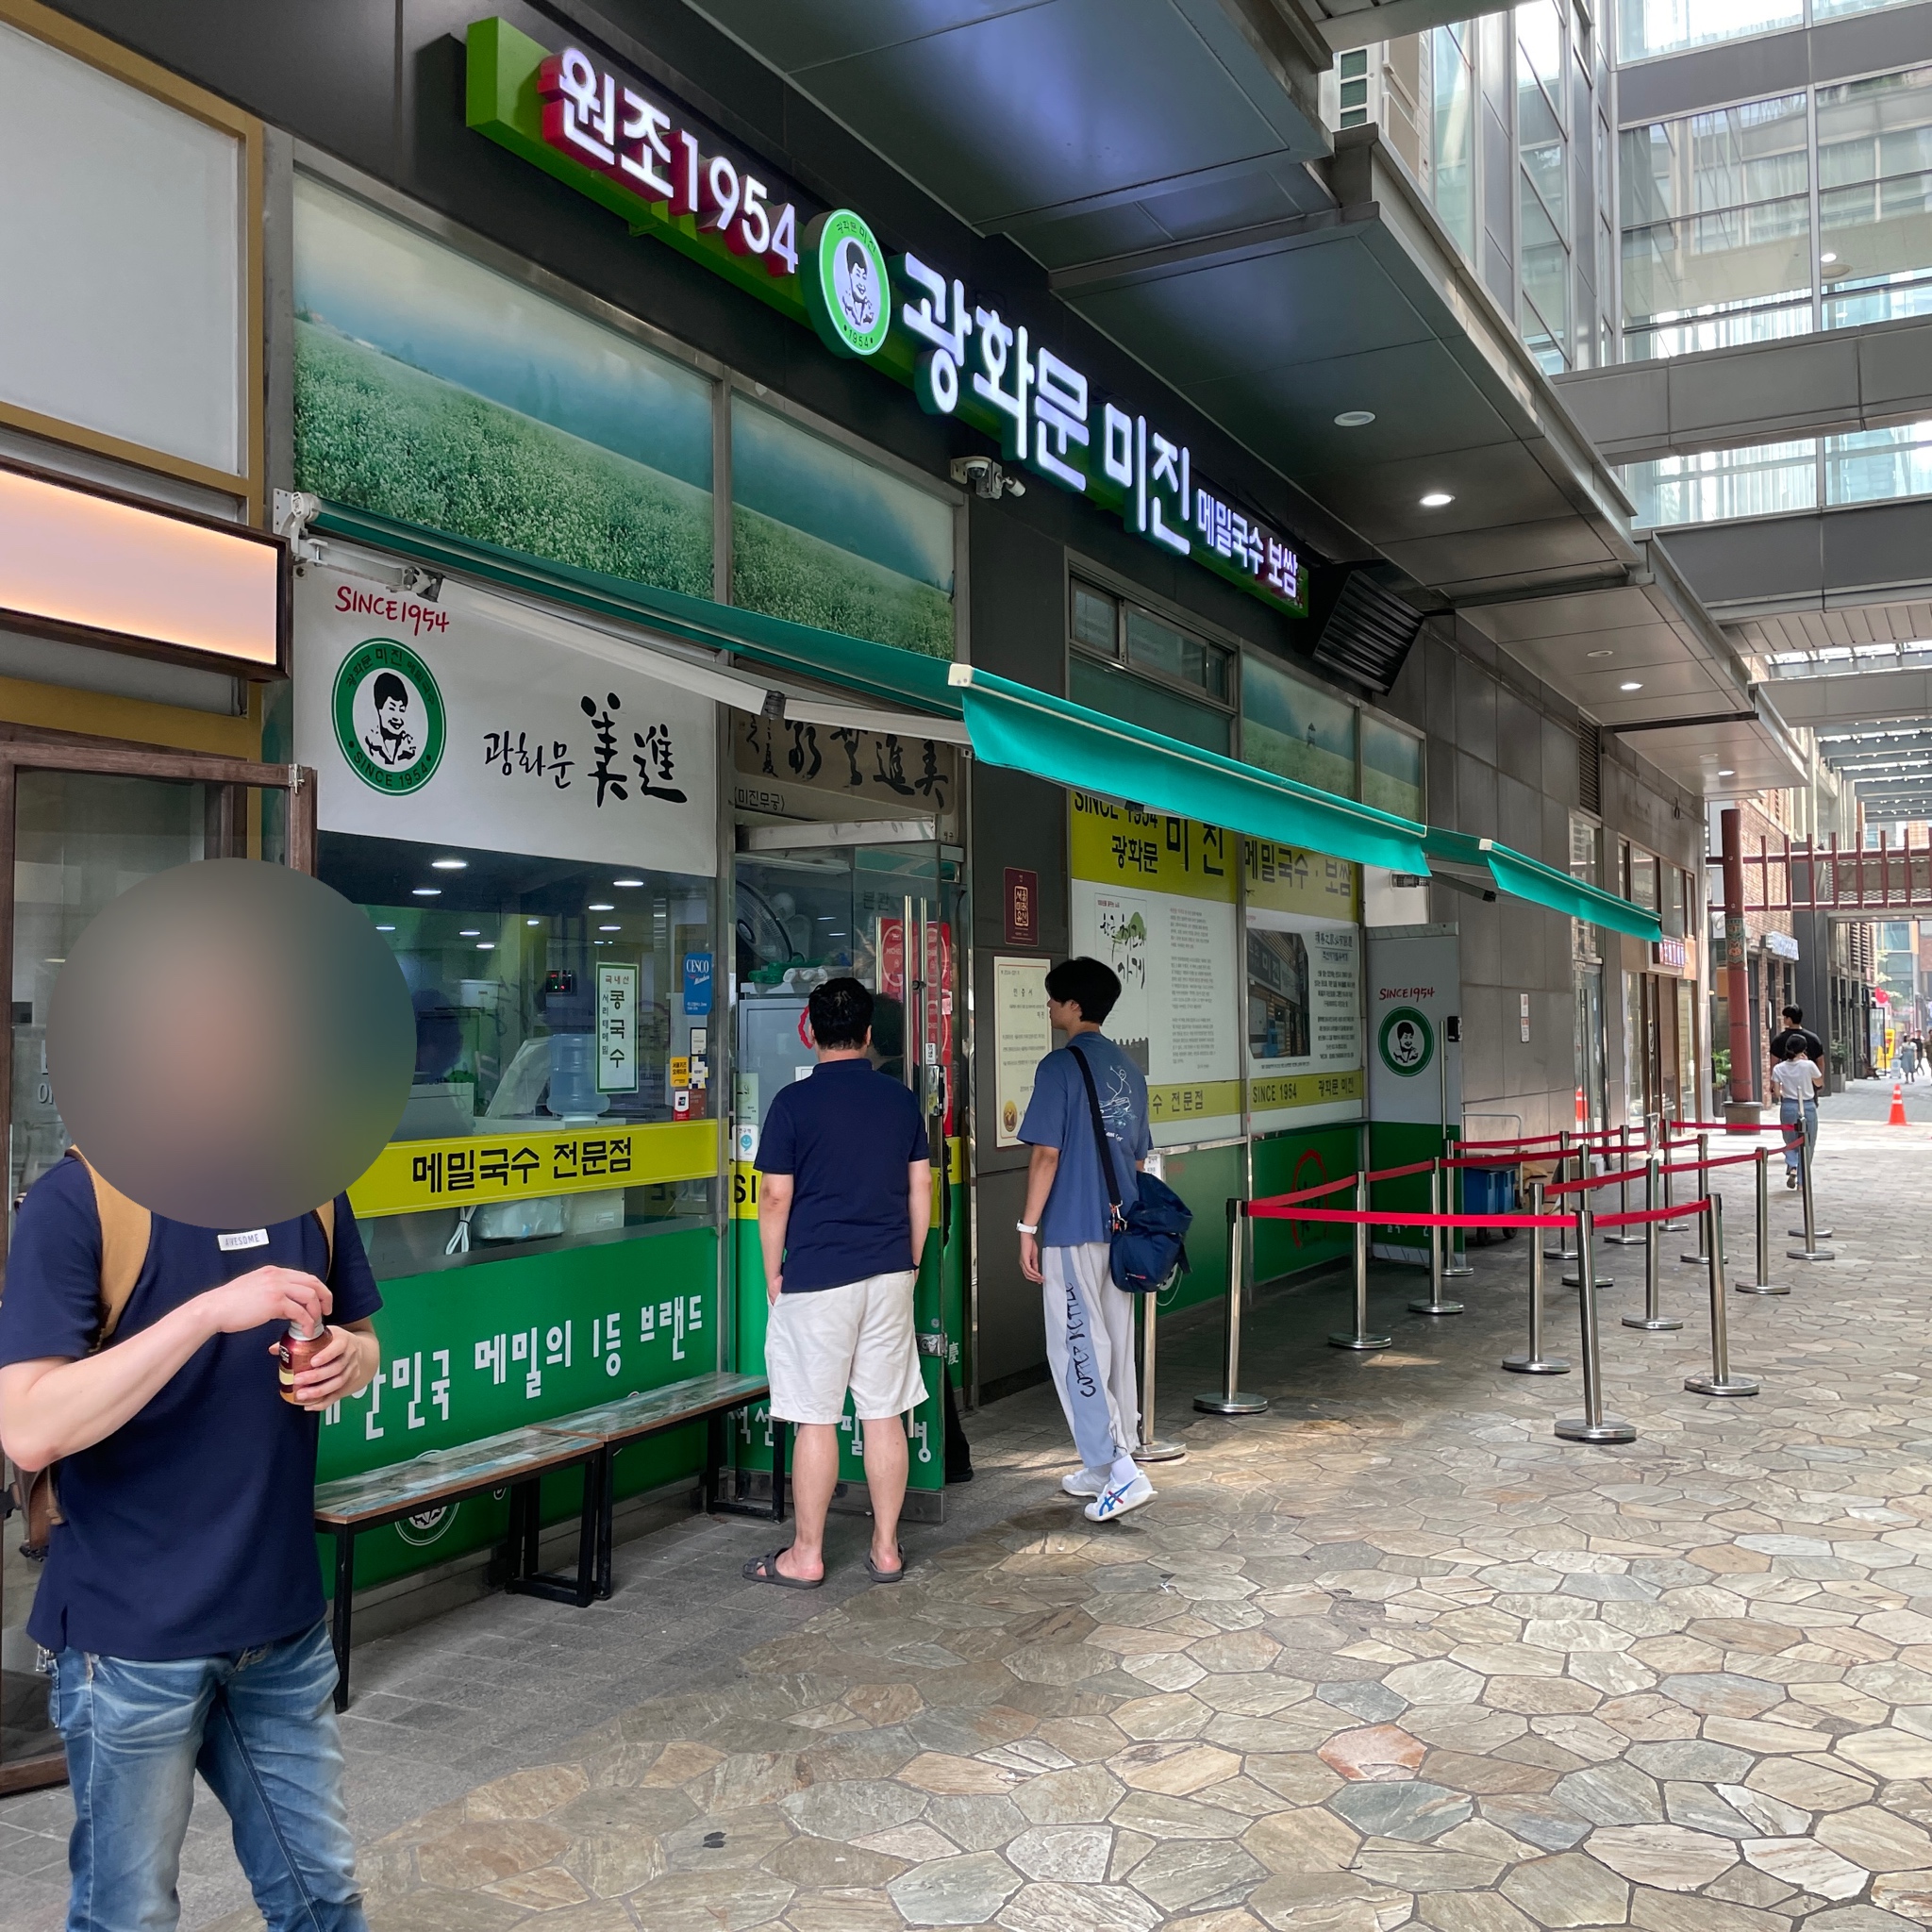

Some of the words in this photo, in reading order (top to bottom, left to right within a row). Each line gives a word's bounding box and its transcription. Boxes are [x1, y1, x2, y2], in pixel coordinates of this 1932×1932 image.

[848, 328, 869, 348] 1954
[903, 251, 1090, 492] 광화문
[1104, 403, 1191, 556] 미진
[1196, 488, 1264, 575] 메밀국수
[1268, 537, 1299, 598] 보쌈
[345, 655, 375, 688] 광화문
[375, 647, 403, 667] 미진
[407, 660, 435, 706] 메밀국수
[354, 751, 393, 787] SINCE
[398, 762, 428, 788] 1954
[483, 730, 575, 790] 광화문
[1111, 835, 1158, 874] 광화문
[1166, 817, 1224, 876] 미진
[1245, 839, 1308, 890] 메밀국수
[1324, 858, 1352, 897] 보쌈
[605, 974, 630, 984] 국내산
[686, 958, 709, 974] CESCO
[609, 990, 625, 1069] 콩국수
[1171, 1089, 1204, 1113] 전문점
[1252, 1084, 1275, 1104] SINCE
[1279, 1082, 1298, 1100] 1954
[1318, 1079, 1340, 1097] 광화문
[1341, 1076, 1355, 1095] 미진
[412, 1146, 541, 1194] 메밀국수
[553, 1136, 633, 1180] 전문점
[225, 1233, 260, 1247] AWESOME
[325, 1348, 451, 1441] 한민국
[475, 1319, 573, 1400] 메밀의
[640, 1294, 704, 1361] 브랜드
